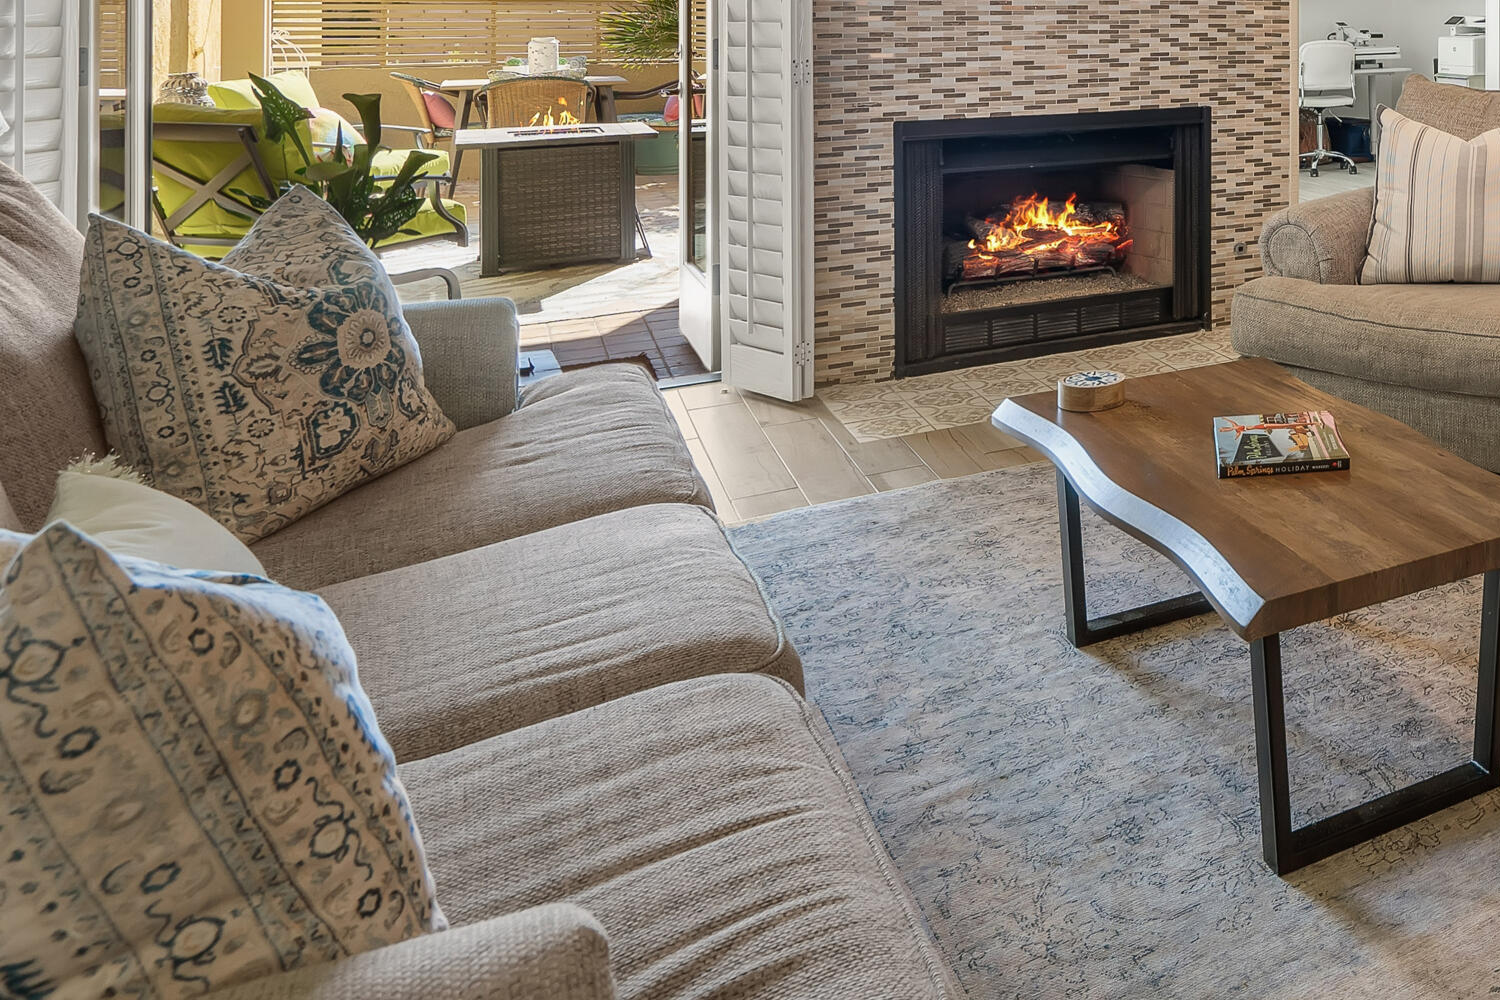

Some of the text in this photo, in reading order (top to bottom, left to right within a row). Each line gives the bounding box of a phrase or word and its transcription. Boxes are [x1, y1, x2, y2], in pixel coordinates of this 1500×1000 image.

[1227, 465, 1246, 477] Palm
[1246, 464, 1274, 476] Springs
[1275, 465, 1310, 473] HOLIDAY
